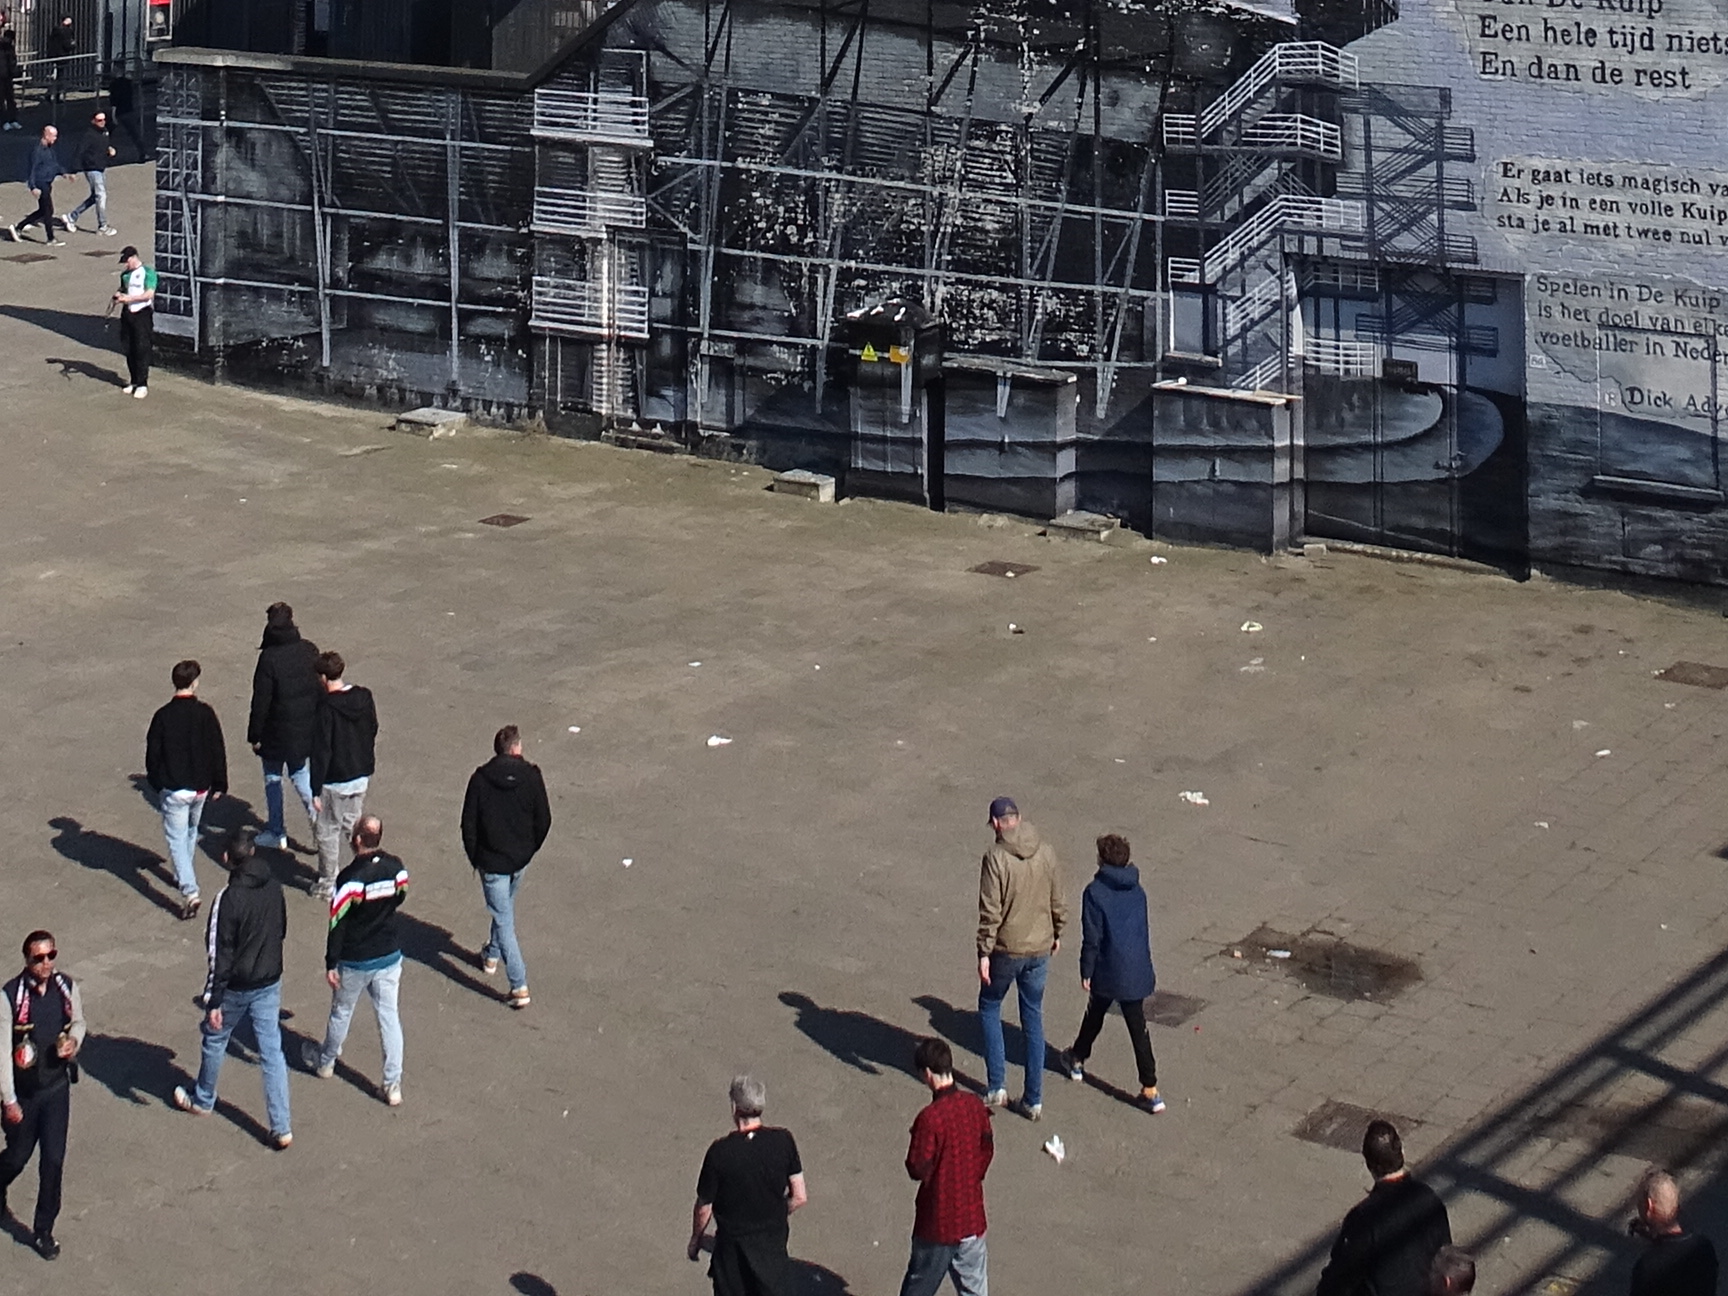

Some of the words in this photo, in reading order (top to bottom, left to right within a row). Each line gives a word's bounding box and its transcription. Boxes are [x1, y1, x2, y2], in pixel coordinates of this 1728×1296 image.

[1479, 14, 1530, 42] Een
[1542, 18, 1598, 48] hele
[1607, 26, 1655, 55] tijd
[1479, 51, 1518, 77] En
[1528, 55, 1582, 82] dan
[1592, 60, 1624, 85] de
[1634, 66, 1692, 90] rest
[1501, 161, 1524, 180] Er
[1531, 165, 1571, 186] gaat
[1579, 168, 1614, 188] iets
[1622, 172, 1700, 195] magisch
[1497, 187, 1530, 206] Als
[1536, 189, 1555, 210] je
[1561, 192, 1580, 210] in
[1589, 196, 1620, 214] een
[1628, 199, 1674, 218] volle
[1681, 202, 1728, 226] Kuip
[1497, 214, 1526, 231] sta
[1532, 214, 1551, 235] je
[1558, 216, 1577, 235] al
[1583, 220, 1620, 239] met
[1625, 223, 1672, 242] twee
[1680, 228, 1712, 246] nul
[1536, 276, 1601, 299] Spelen
[1608, 283, 1629, 301] in
[1636, 284, 1664, 304] De
[1674, 288, 1721, 313] Kuip
[1537, 300, 1553, 319] is
[1560, 302, 1591, 323] het
[1598, 307, 1640, 328] doel
[1648, 314, 1685, 332] van
[1539, 329, 1638, 354] voetballer
[1644, 337, 1665, 356] in
[1625, 385, 1674, 409] Dick
